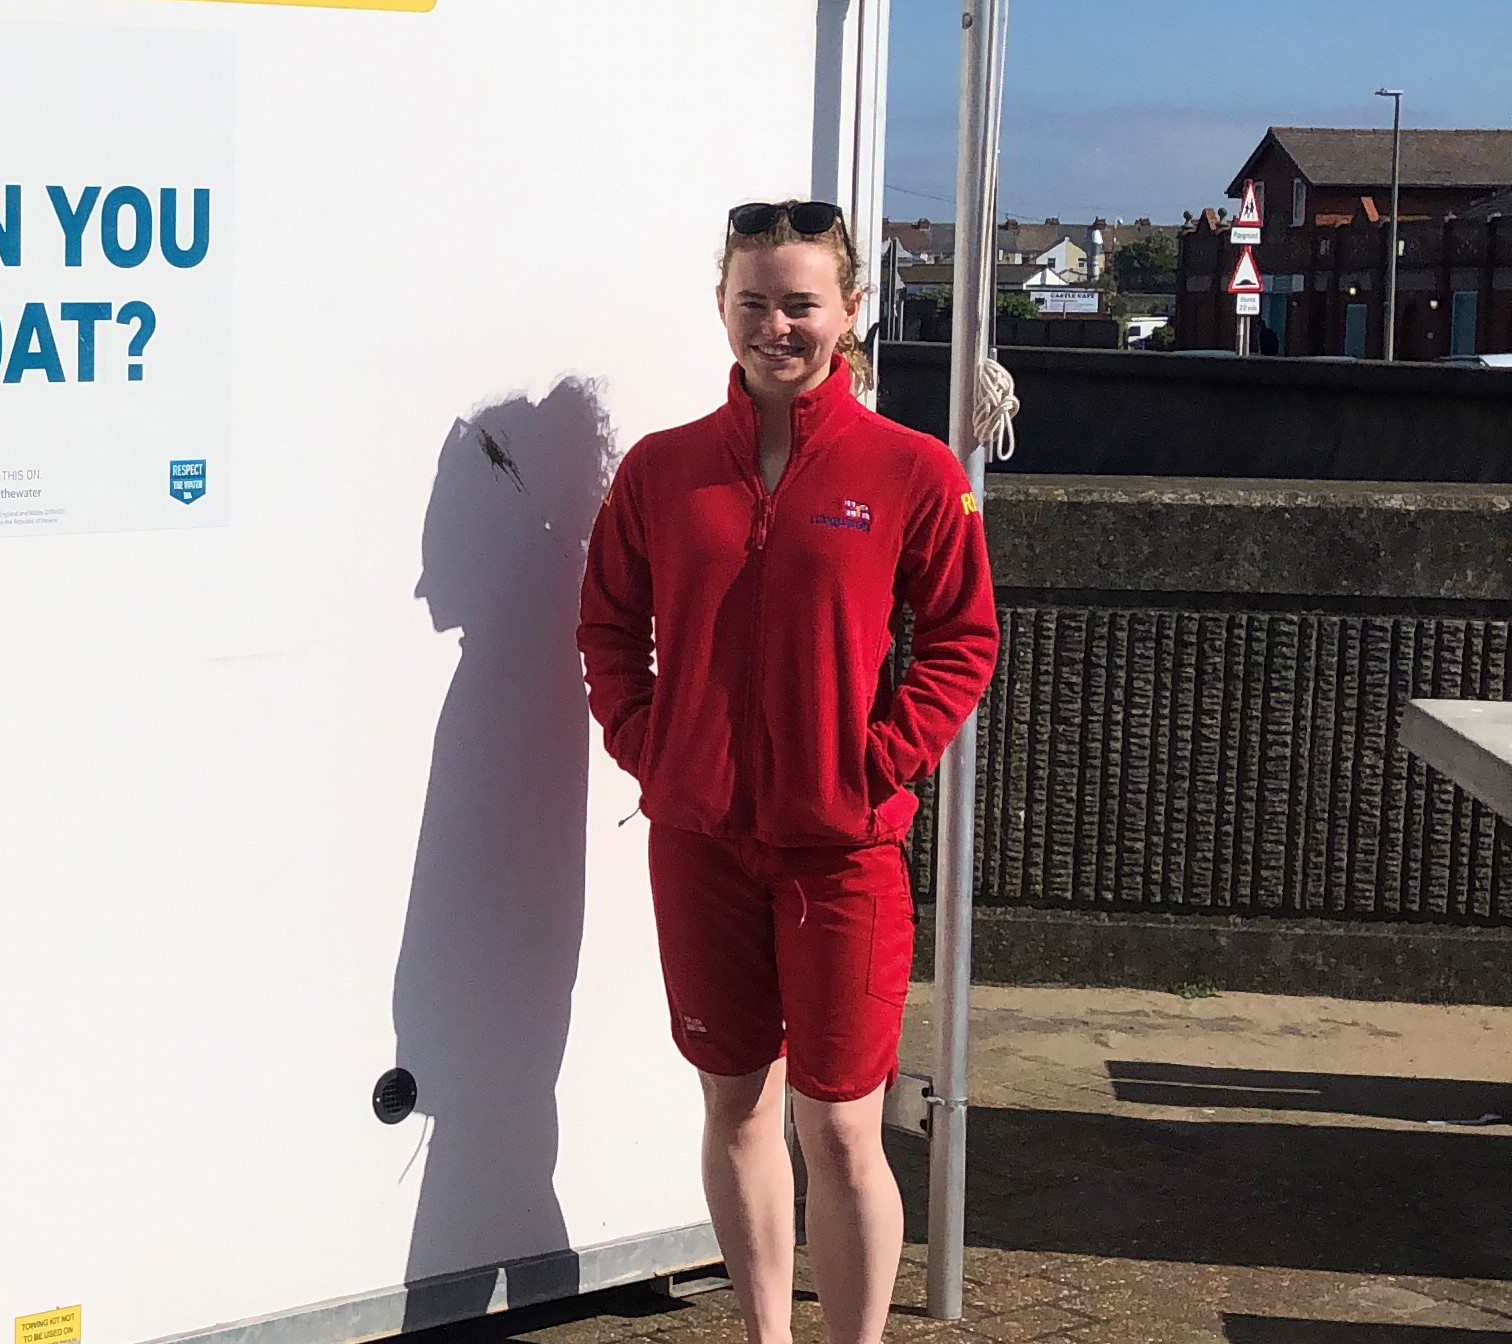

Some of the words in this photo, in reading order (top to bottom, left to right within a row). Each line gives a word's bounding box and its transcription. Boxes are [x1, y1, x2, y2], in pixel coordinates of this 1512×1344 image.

[45, 185, 211, 269] YOU
[1, 469, 24, 481] THIS
[172, 463, 204, 476] RESPECT
[23, 1334, 33, 1344] TO
